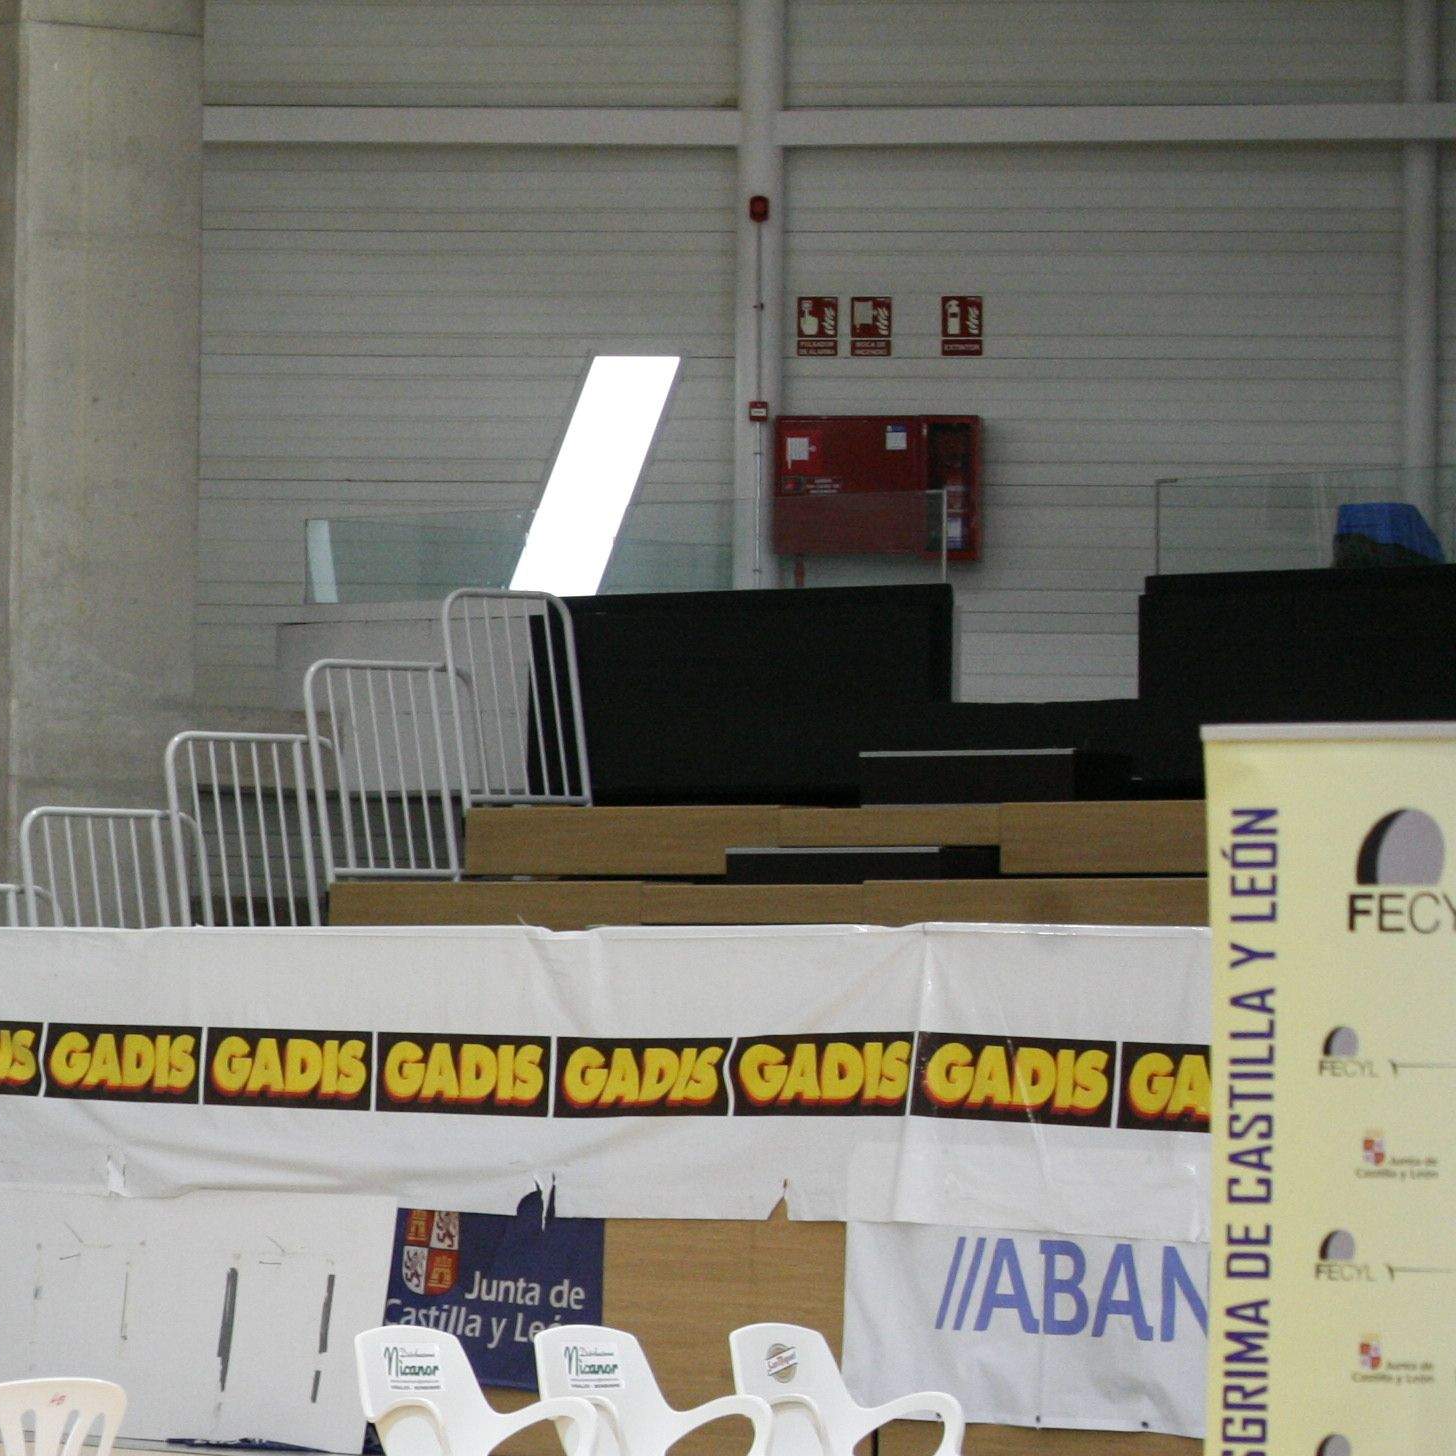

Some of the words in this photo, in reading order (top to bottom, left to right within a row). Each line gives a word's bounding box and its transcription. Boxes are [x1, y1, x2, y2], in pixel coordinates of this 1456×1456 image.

[1221, 807, 1279, 922] LEÓN
[1230, 942, 1276, 969] Y
[49, 1031, 195, 1092] GADIS
[210, 1035, 365, 1097] GADIS
[383, 1040, 544, 1104] GADIS
[563, 1044, 723, 1106] GADIS
[738, 1039, 912, 1104] GADIS
[925, 1041, 1109, 1112] GADIS
[1227, 988, 1276, 1203] CASTILLA
[1225, 1224, 1272, 1278] DE
[465, 1271, 541, 1308] Junta
[549, 1279, 586, 1310] de
[487, 1316, 508, 1349] y
[514, 1312, 566, 1343] Le
